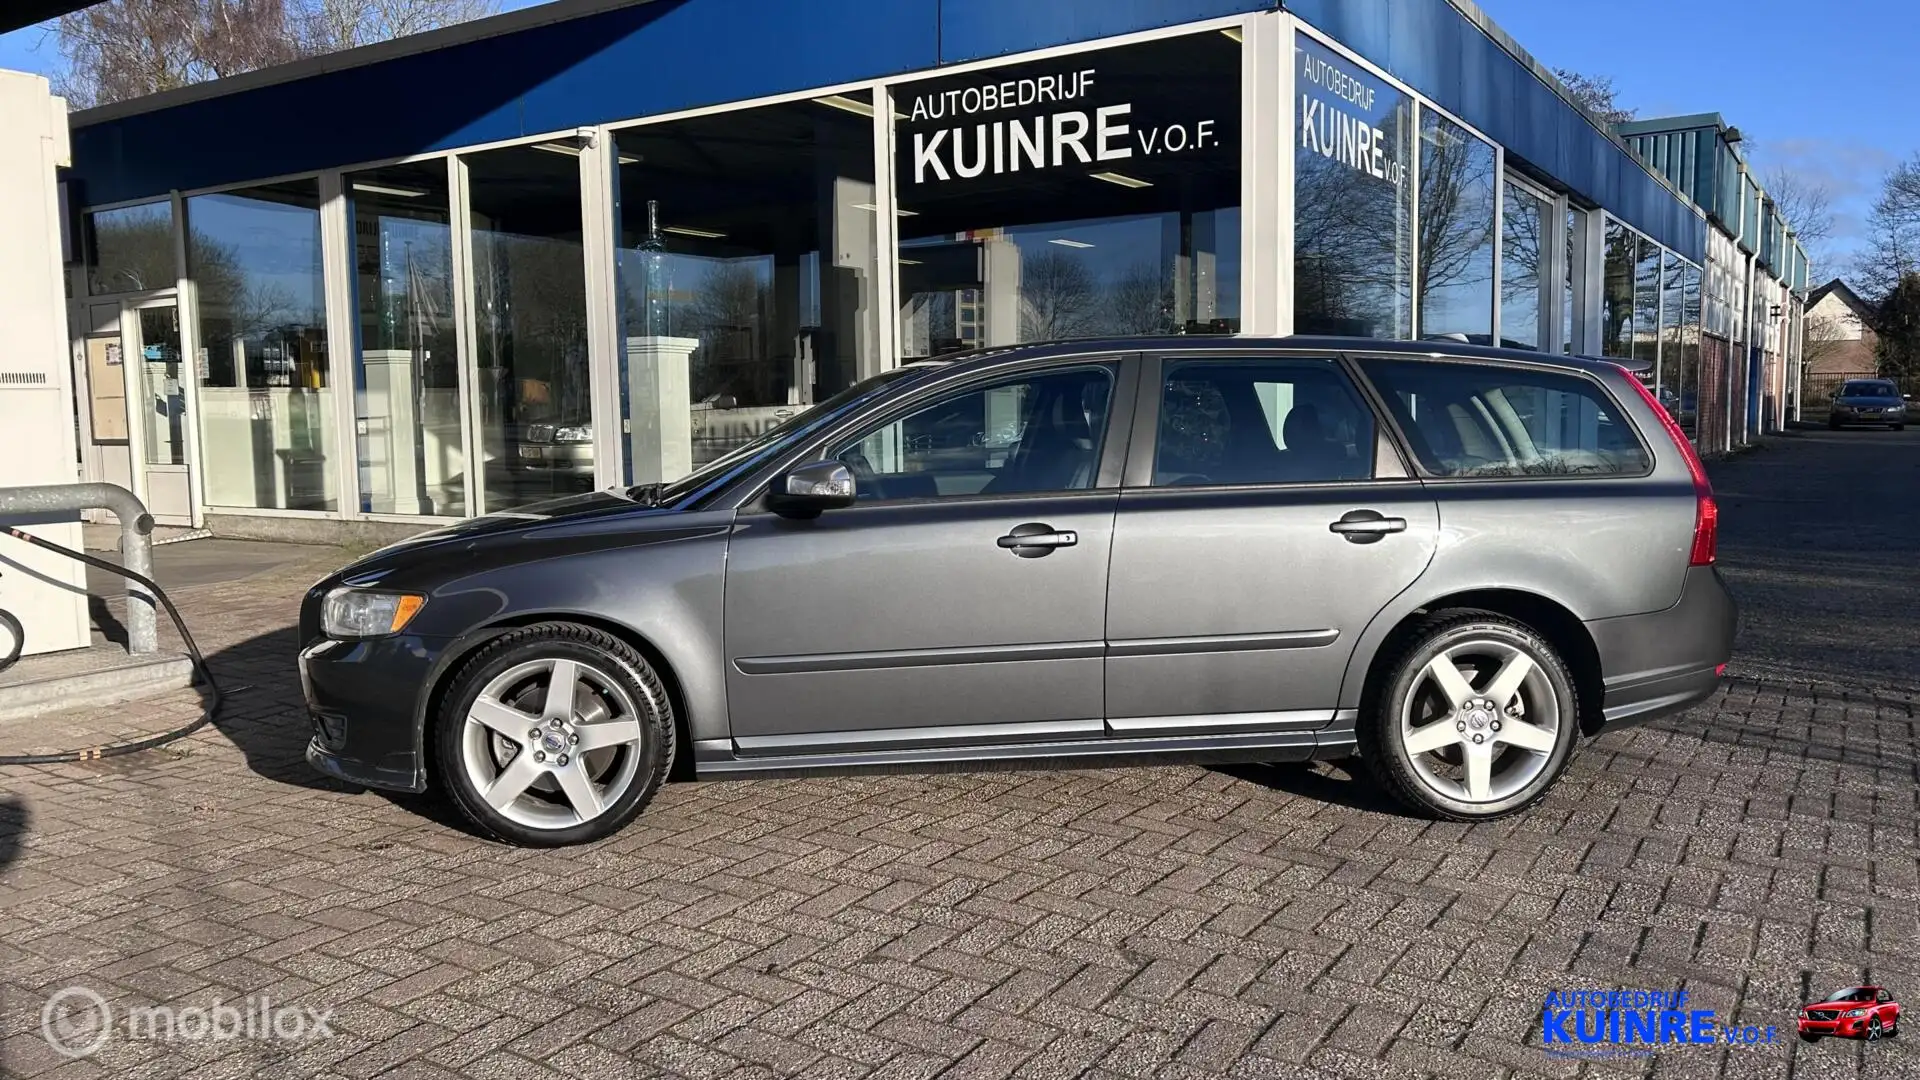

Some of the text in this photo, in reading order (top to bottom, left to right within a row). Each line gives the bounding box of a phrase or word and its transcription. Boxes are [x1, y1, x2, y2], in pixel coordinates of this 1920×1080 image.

[911, 69, 1095, 122] AUTOBEDRIJF
[1304, 53, 1375, 112] AUTOBEDRIJF
[914, 103, 1219, 184] KUINRE V.O.F.
[1302, 94, 1384, 179] KUINRE
